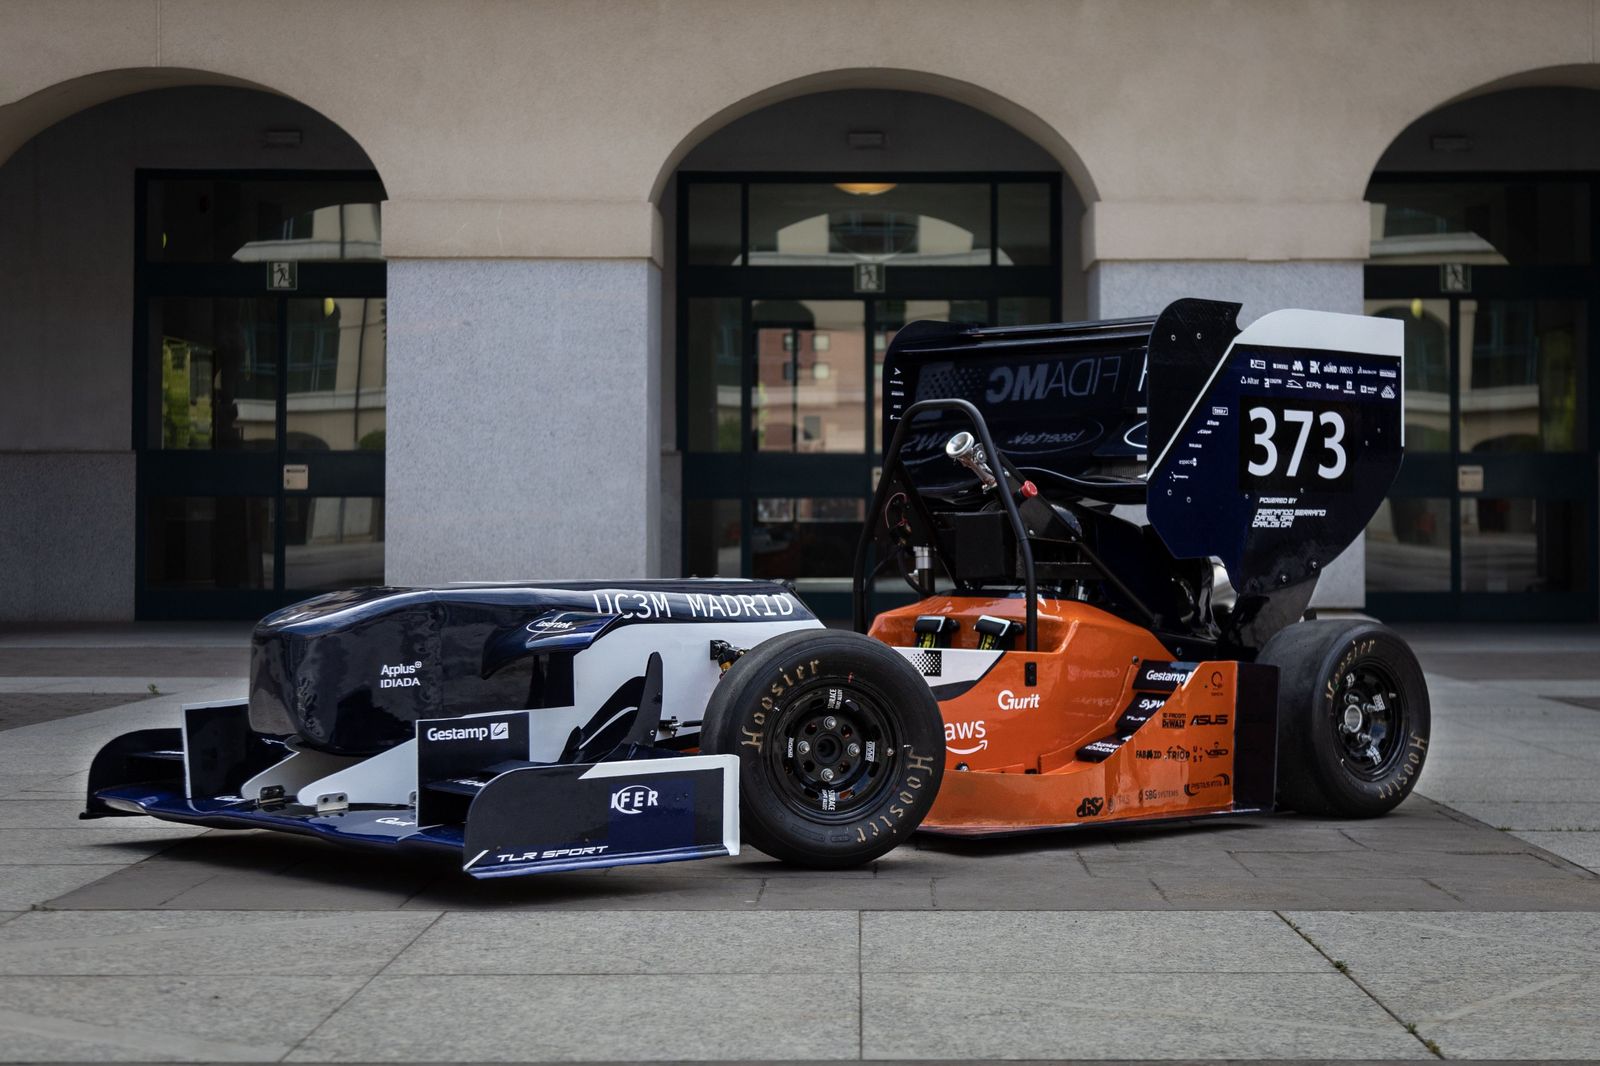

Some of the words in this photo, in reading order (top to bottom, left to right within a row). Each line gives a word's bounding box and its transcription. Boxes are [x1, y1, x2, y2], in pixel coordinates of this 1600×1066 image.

[1247, 406, 1347, 480] 373
[592, 592, 672, 619] UC3M
[684, 593, 794, 617] MADRID
[380, 663, 416, 677] Applus
[1145, 669, 1186, 683] Gestamp
[380, 677, 421, 689] IDIADA
[741, 658, 820, 754] Hoosier
[997, 689, 1040, 710] Gurit
[1190, 714, 1229, 726] ASUS
[427, 727, 489, 741] Gestamp
[944, 720, 987, 741] aws
[856, 744, 934, 843] Hoosier
[1145, 788, 1158, 801] SBG
[497, 852, 538, 862] TLR
[541, 845, 609, 859] SPORT
